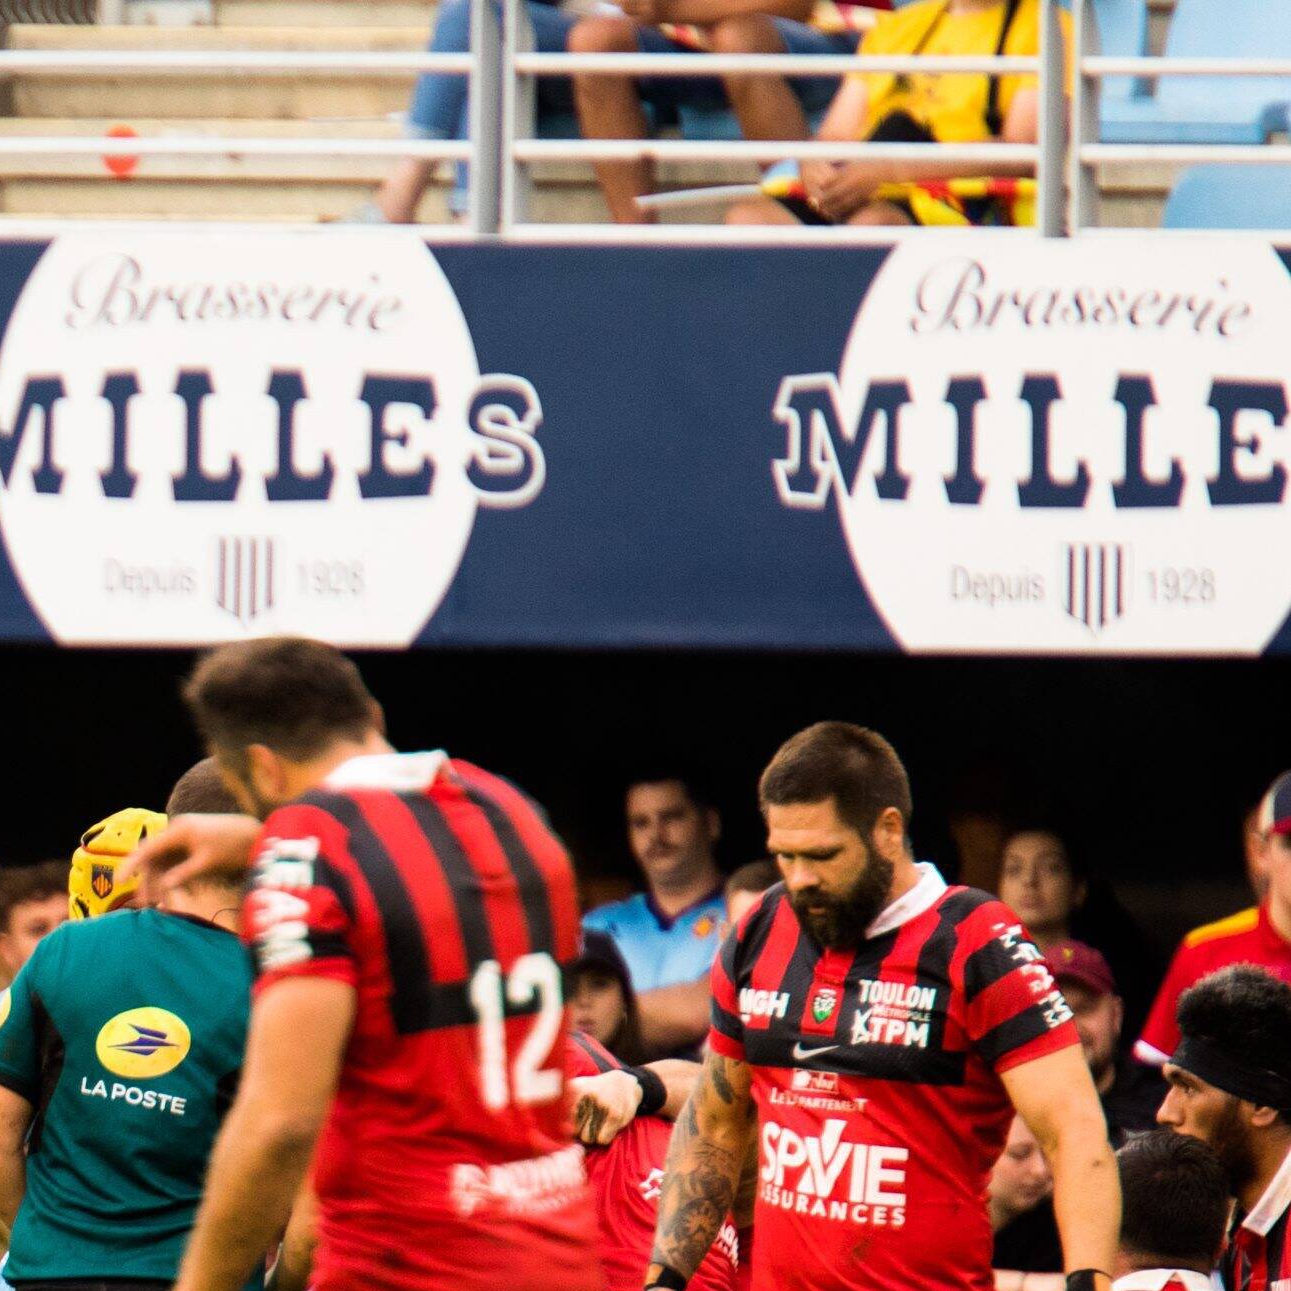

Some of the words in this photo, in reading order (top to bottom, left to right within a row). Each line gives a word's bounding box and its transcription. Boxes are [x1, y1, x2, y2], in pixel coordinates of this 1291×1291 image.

[64, 254, 406, 337] Brasserie
[908, 258, 1253, 340] Brasserie
[102, 556, 197, 601] Depuis
[294, 559, 365, 596] 1928
[950, 562, 1045, 605] Depuis
[1145, 565, 1216, 602] 1928
[858, 978, 938, 1010] TOULON
[469, 951, 564, 1111] 12
[870, 1017, 930, 1049] TPM
[81, 1076, 108, 1098] LA
[110, 1082, 187, 1116] POSTE
